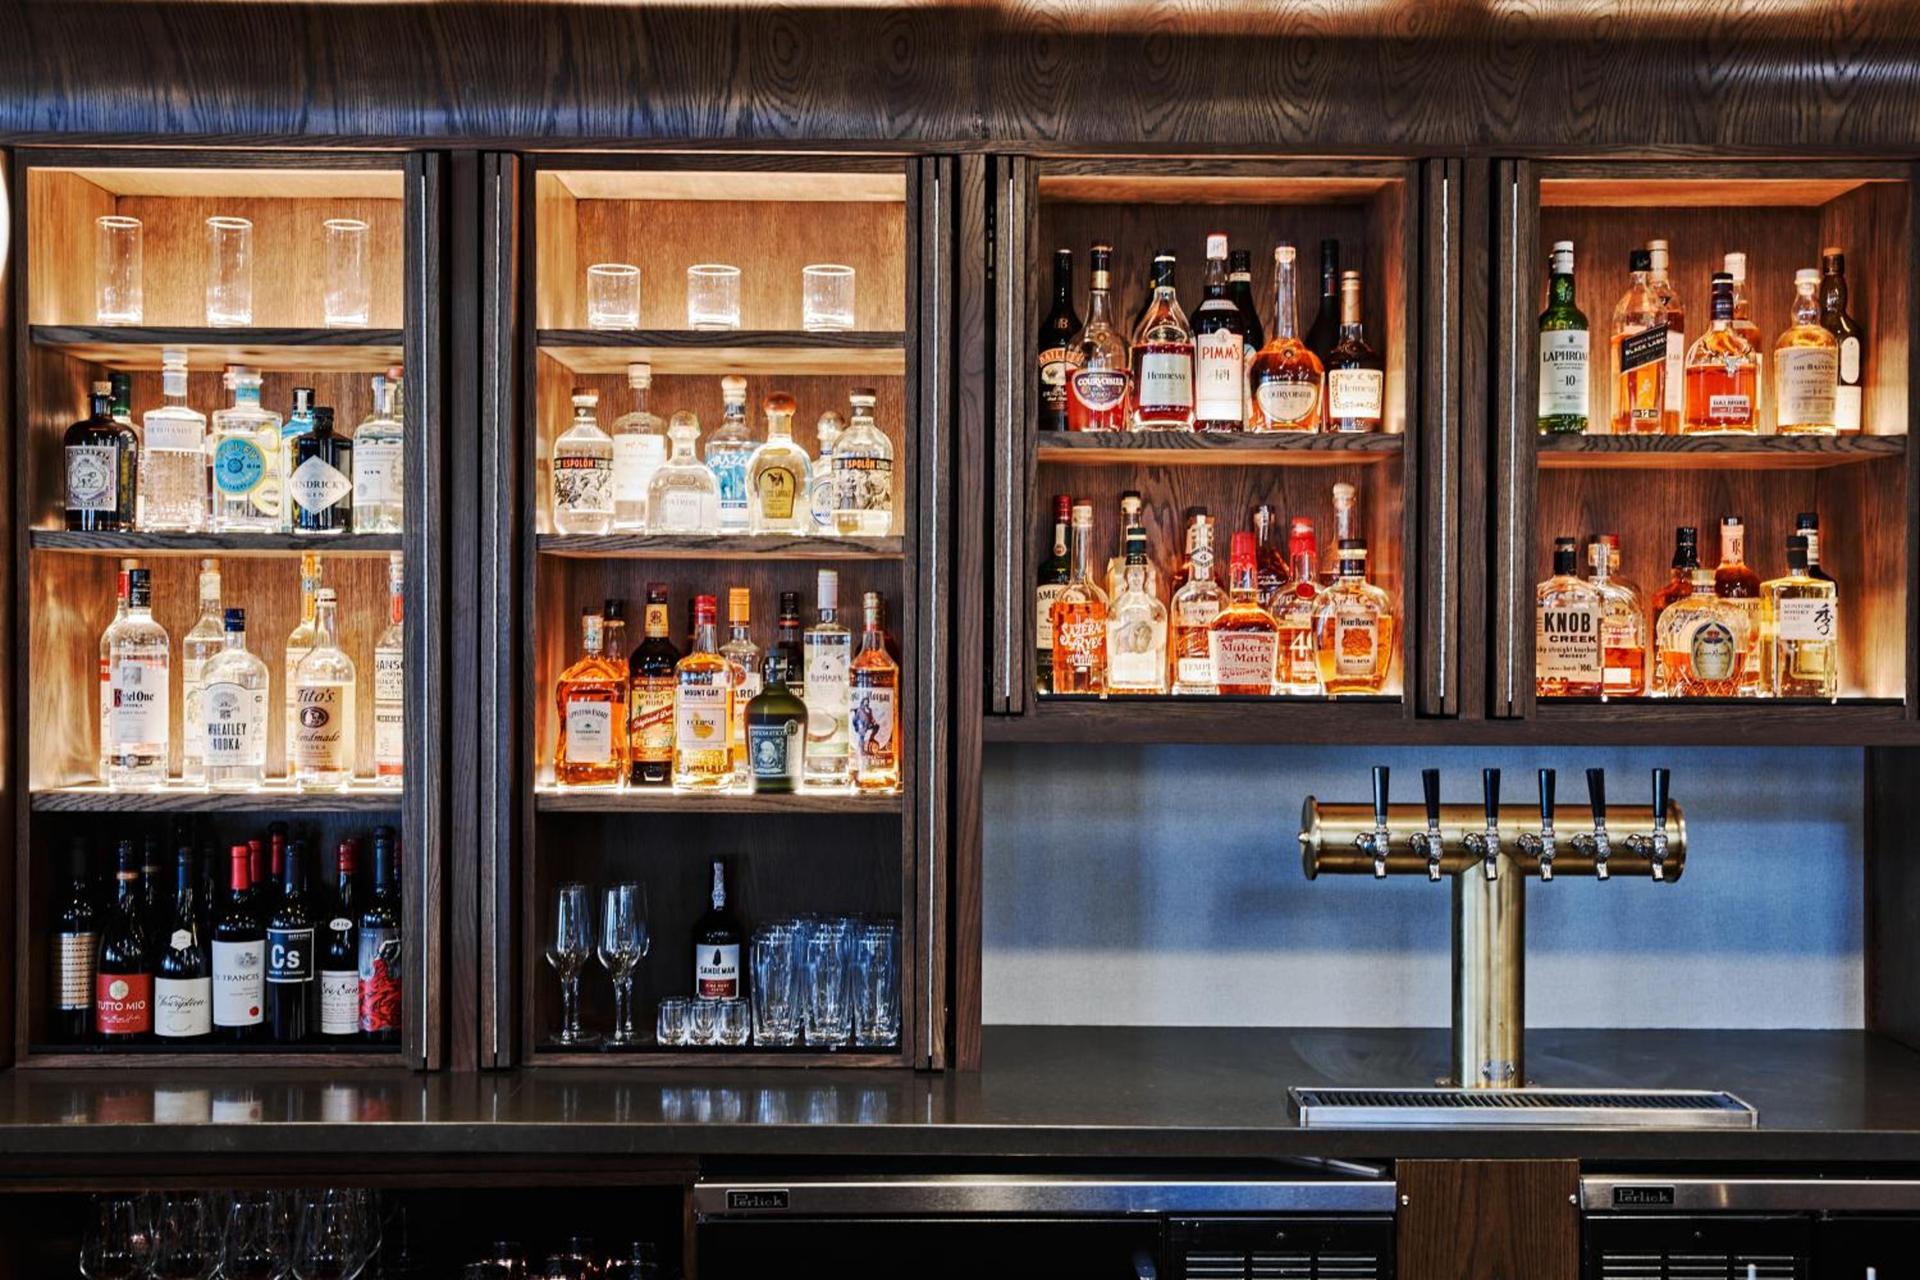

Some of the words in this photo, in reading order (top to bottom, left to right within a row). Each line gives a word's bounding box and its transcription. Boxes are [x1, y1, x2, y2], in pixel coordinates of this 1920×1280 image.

[1202, 344, 1240, 360] PIMM'S
[1147, 372, 1186, 381] Hennessy
[1565, 375, 1576, 386] 10
[1544, 612, 1591, 633] KNOB
[1549, 635, 1597, 643] CREEK
[1222, 641, 1272, 653] Maker's
[1234, 653, 1270, 664] Mark
[1580, 664, 1592, 672] 100
[136, 691, 154, 702] One
[298, 688, 336, 704] Tito's
[684, 688, 706, 697] MOUNT
[208, 722, 247, 737] WHEATLEY
[213, 737, 241, 751] VODKA
[271, 944, 300, 969] Cs
[126, 1000, 146, 1010] MIO
[733, 1194, 783, 1208] Perlick
[1619, 1189, 1670, 1203] Perlick
